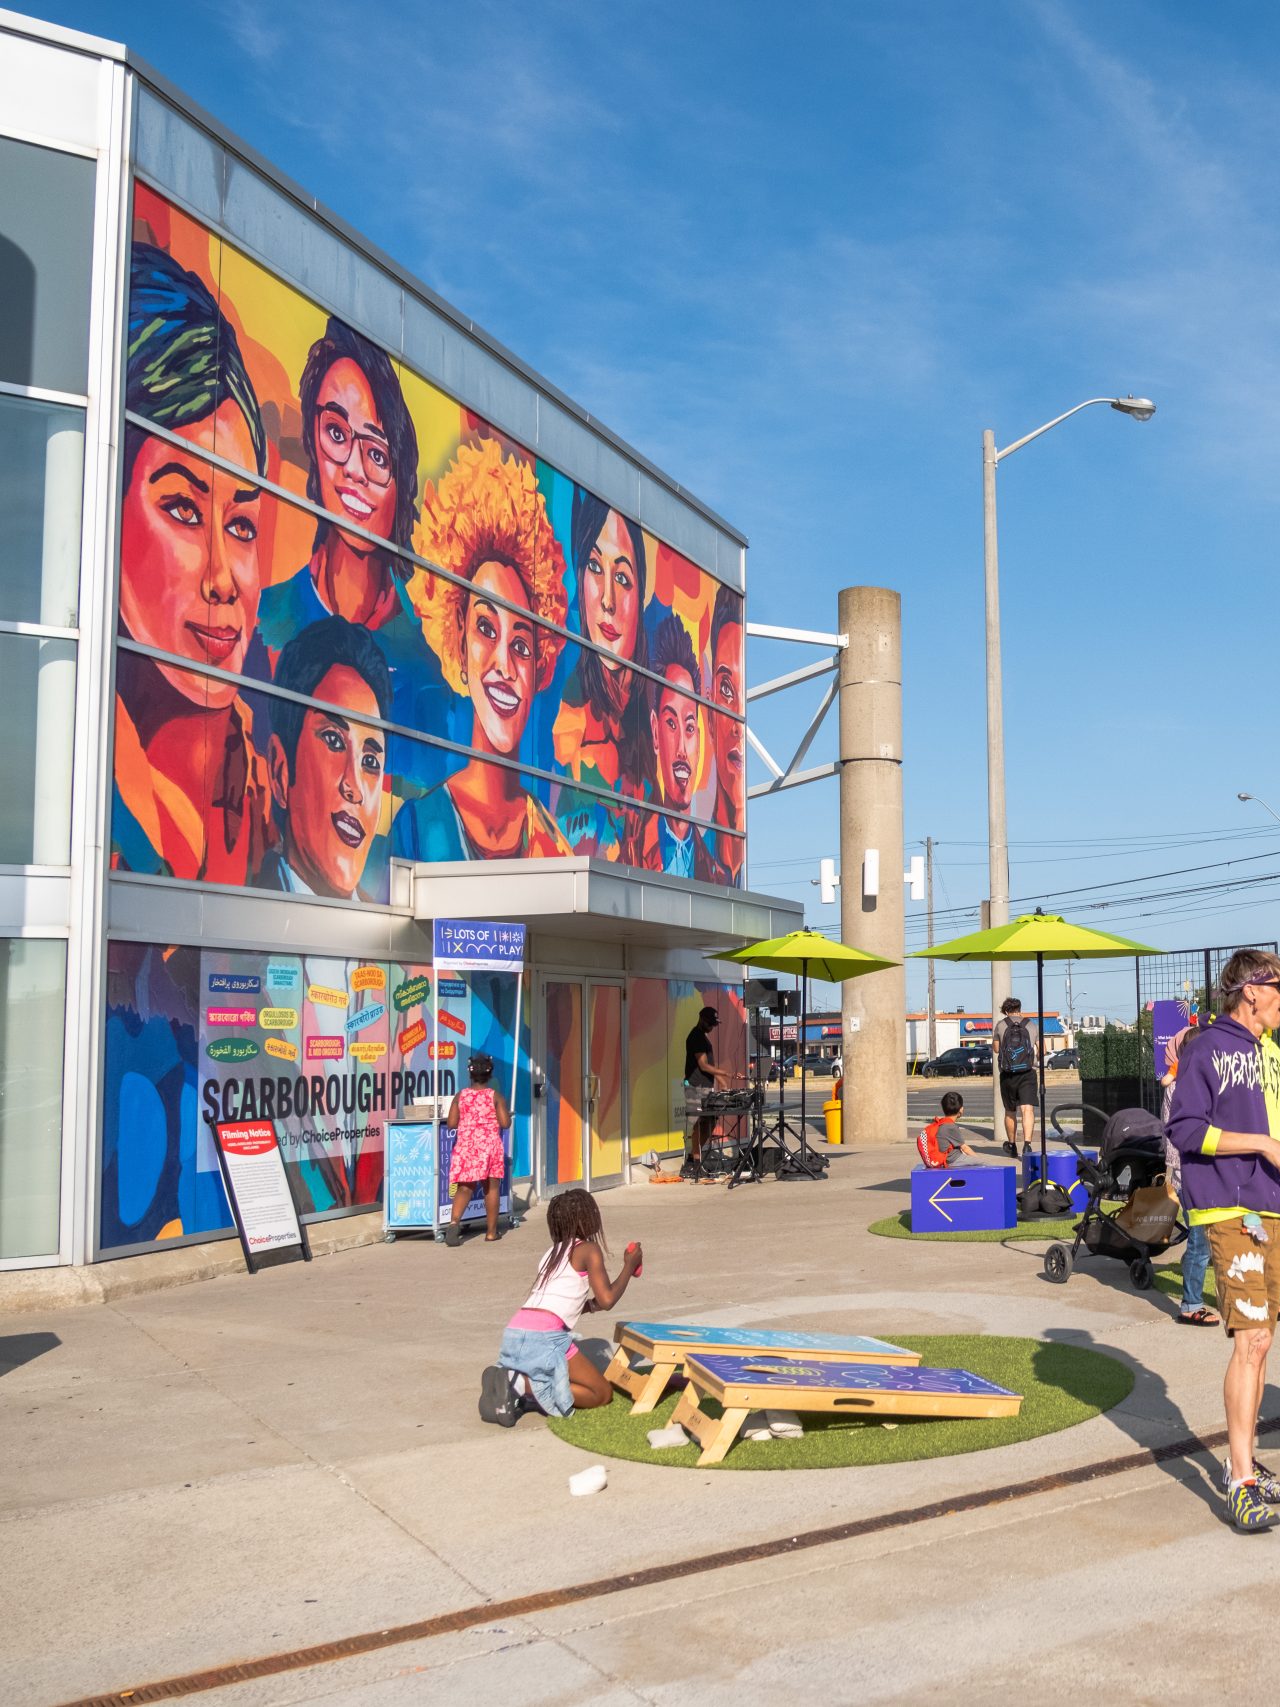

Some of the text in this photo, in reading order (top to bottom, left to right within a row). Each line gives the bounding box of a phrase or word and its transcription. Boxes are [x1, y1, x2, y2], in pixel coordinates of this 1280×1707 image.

[454, 928, 490, 941] LOTS OF
[498, 945, 522, 956] PLAY
[354, 978, 383, 989] SCARBOROUGH
[264, 1019, 294, 1027] SCARBOROUGH
[202, 1069, 456, 1123] SCARBOROUGH PROUD
[221, 1128, 271, 1140] Filming Notice
[289, 1131, 300, 1148] by
[302, 1126, 380, 1145] ChoiceProperties
[249, 1230, 297, 1246] ChoiceProperties
